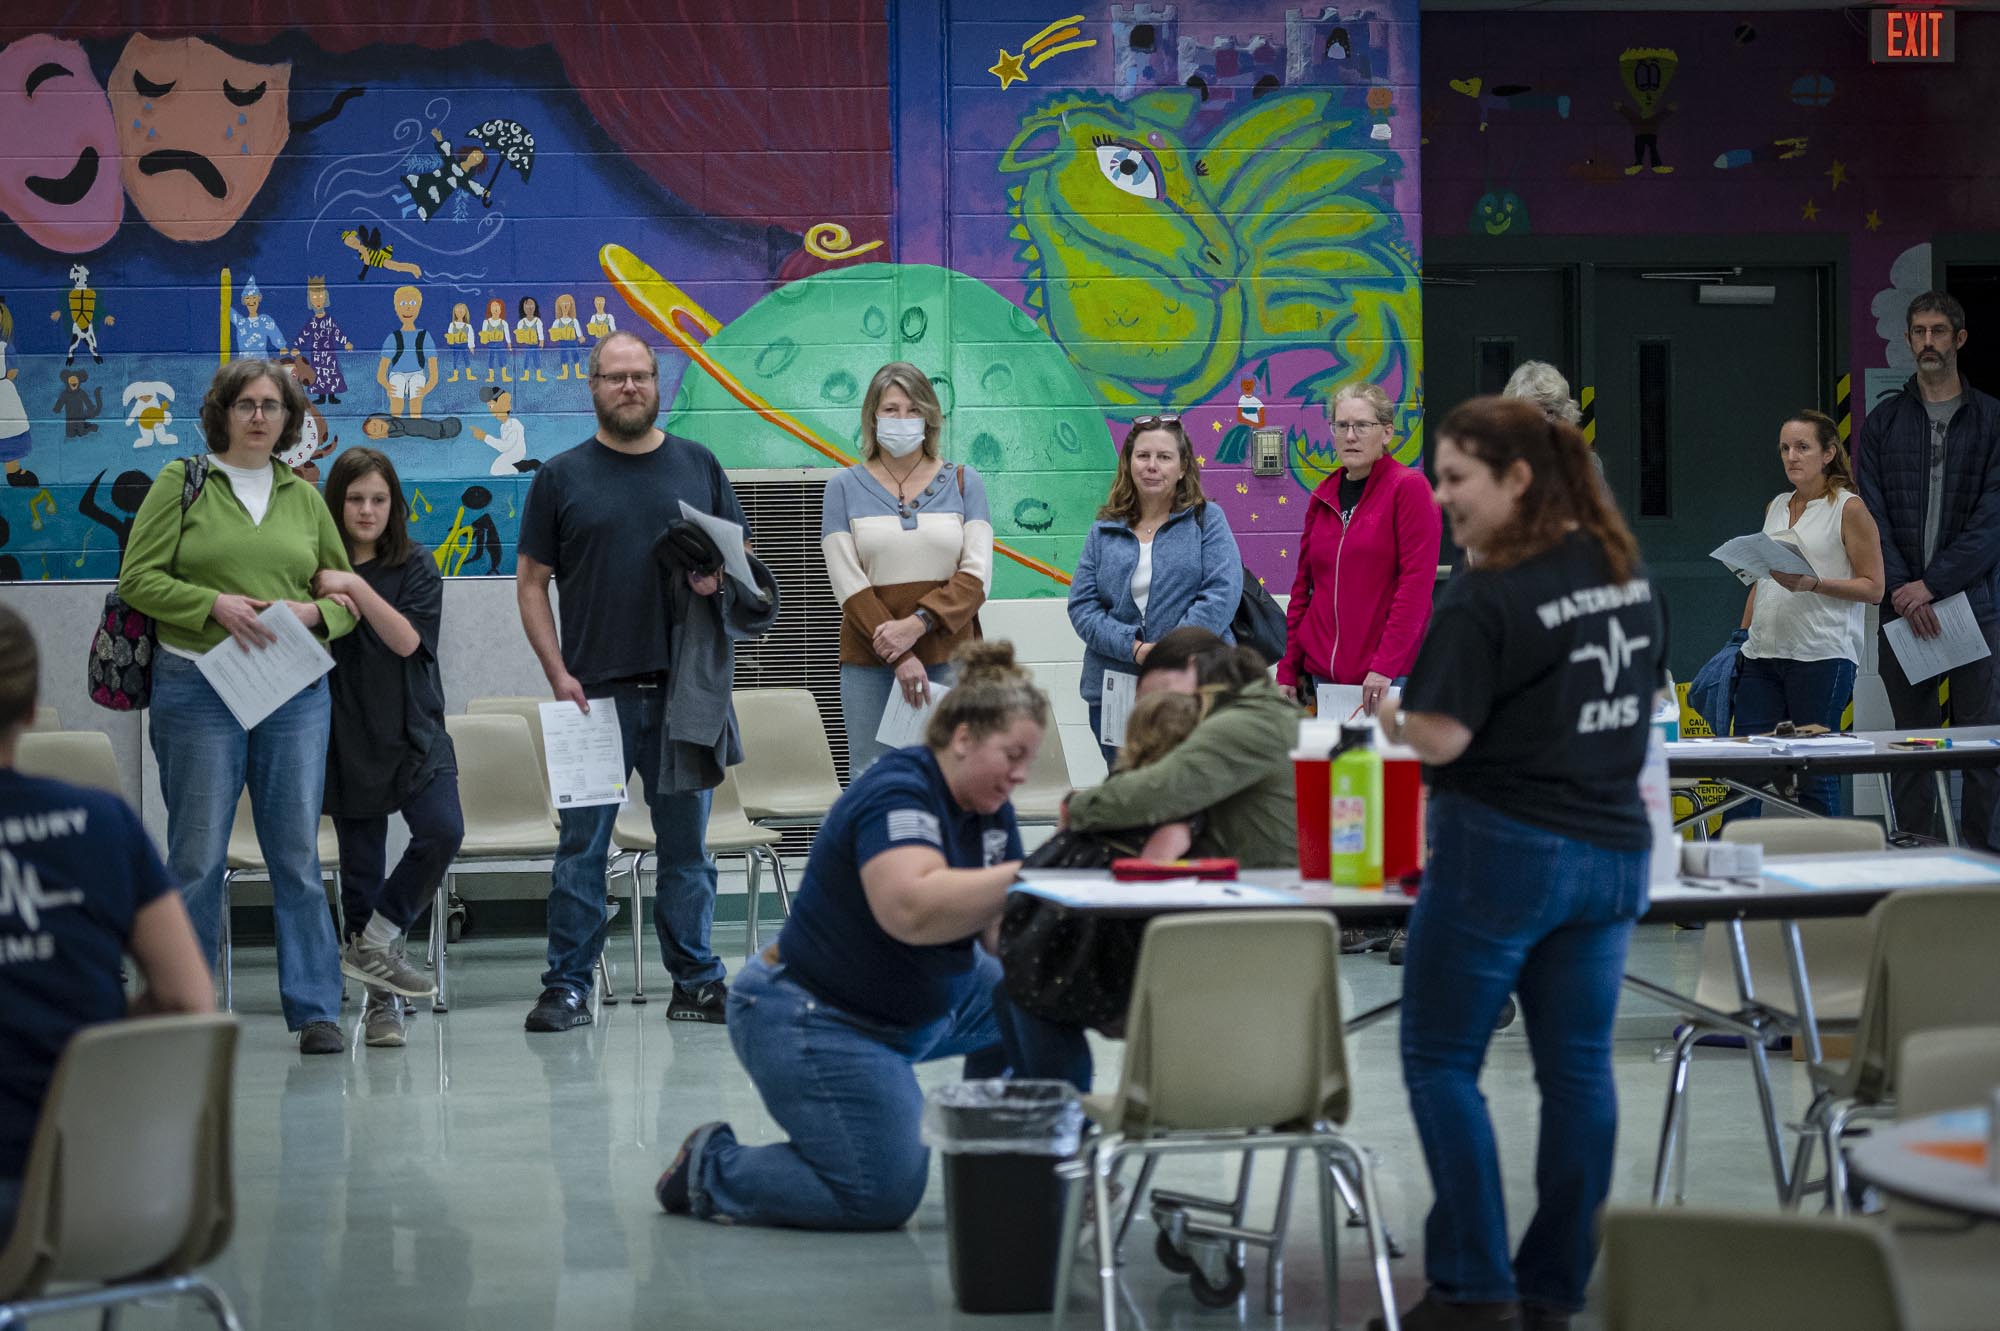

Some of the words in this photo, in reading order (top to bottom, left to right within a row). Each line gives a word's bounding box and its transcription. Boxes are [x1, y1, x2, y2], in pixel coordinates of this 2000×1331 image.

[1887, 11, 1944, 57] EXIT
[1577, 695, 1640, 733] EMS
[1689, 718, 1708, 727] CAUT
[0, 807, 88, 844] BURY
